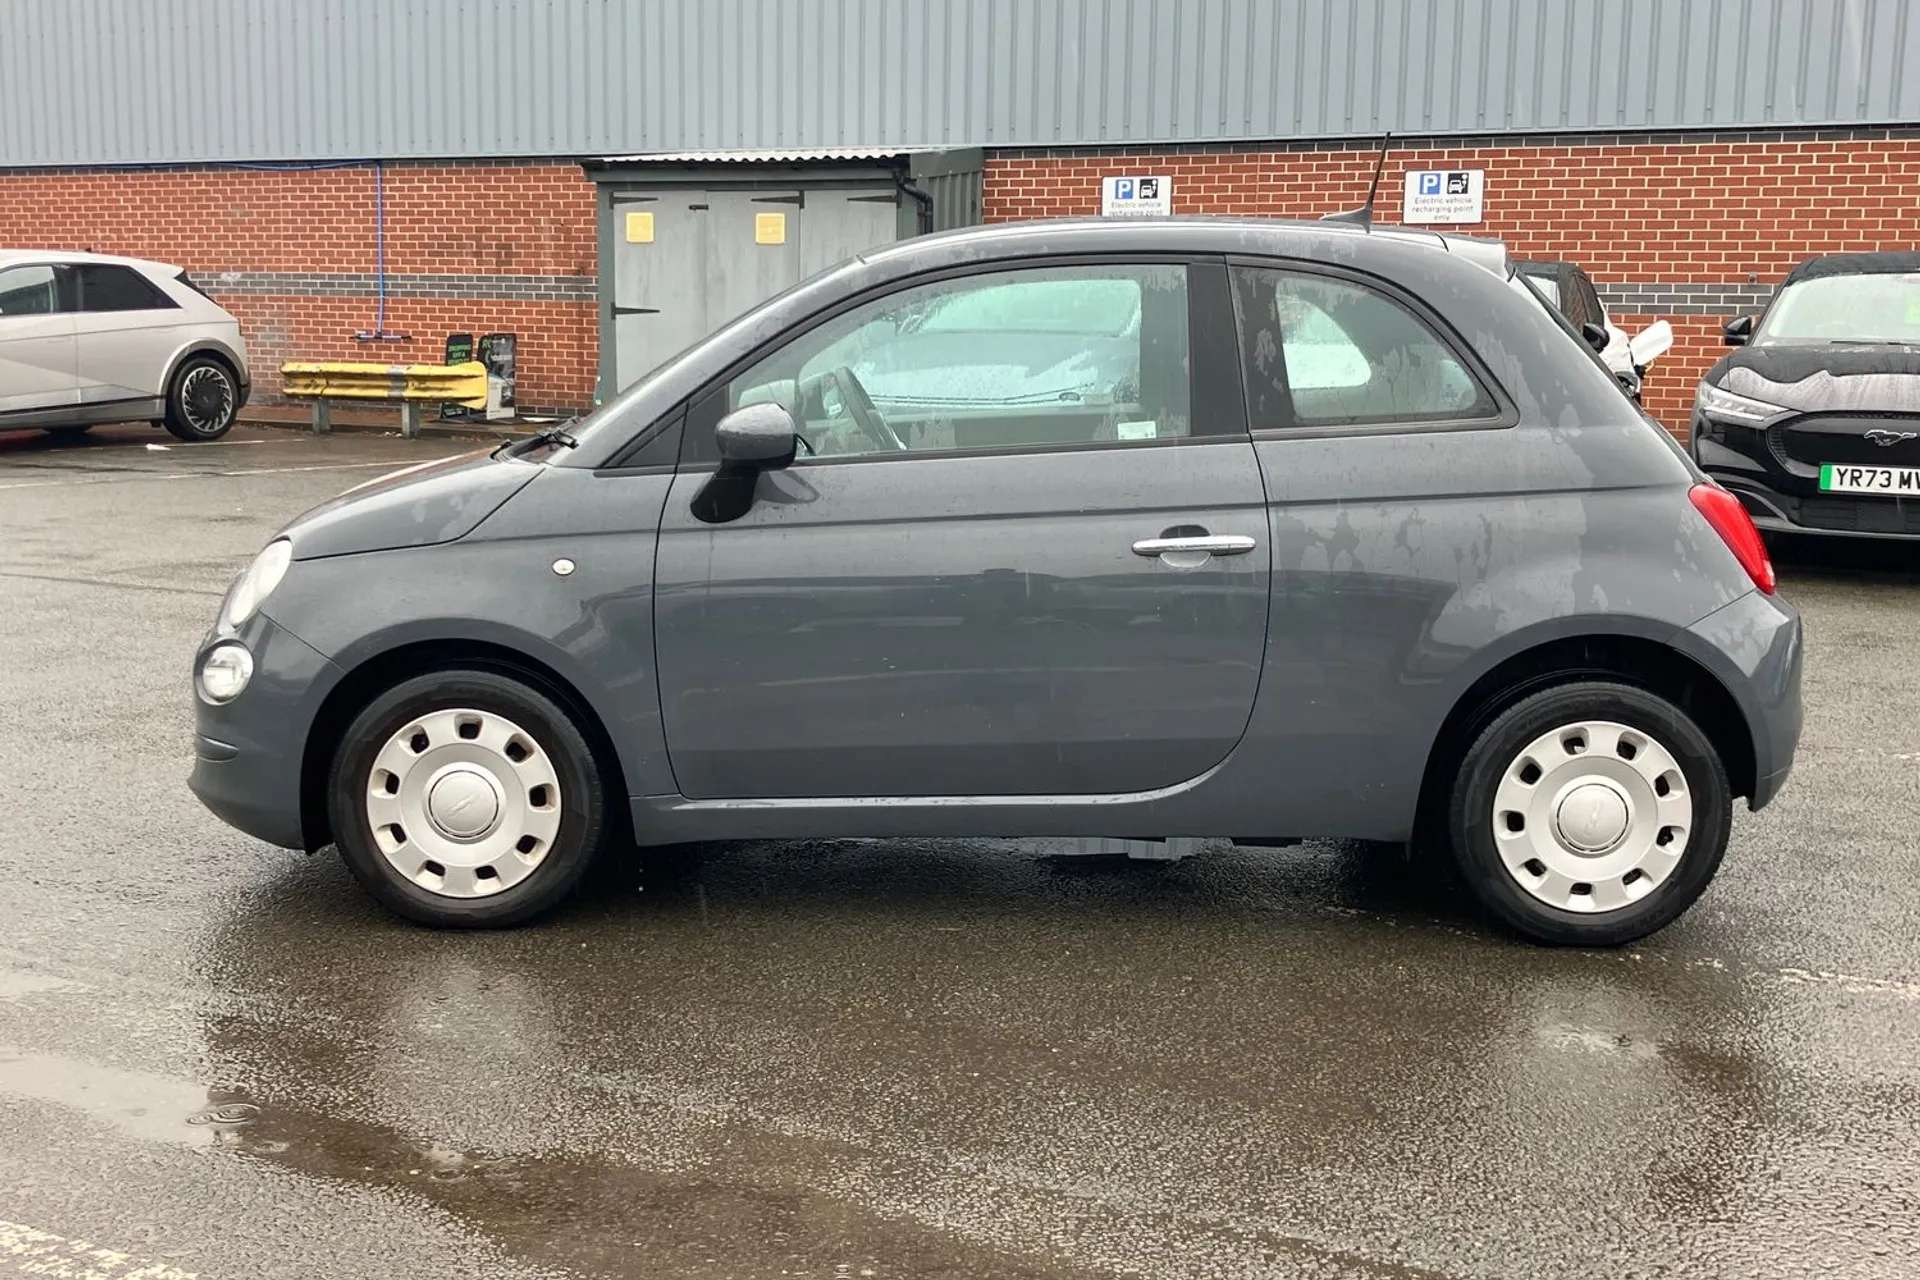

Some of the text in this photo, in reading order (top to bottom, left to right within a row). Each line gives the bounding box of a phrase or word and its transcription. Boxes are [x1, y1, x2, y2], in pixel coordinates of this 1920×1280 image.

[1117, 180, 1131, 199] P
[1423, 174, 1438, 194] P
[1836, 467, 1892, 488] YR73
